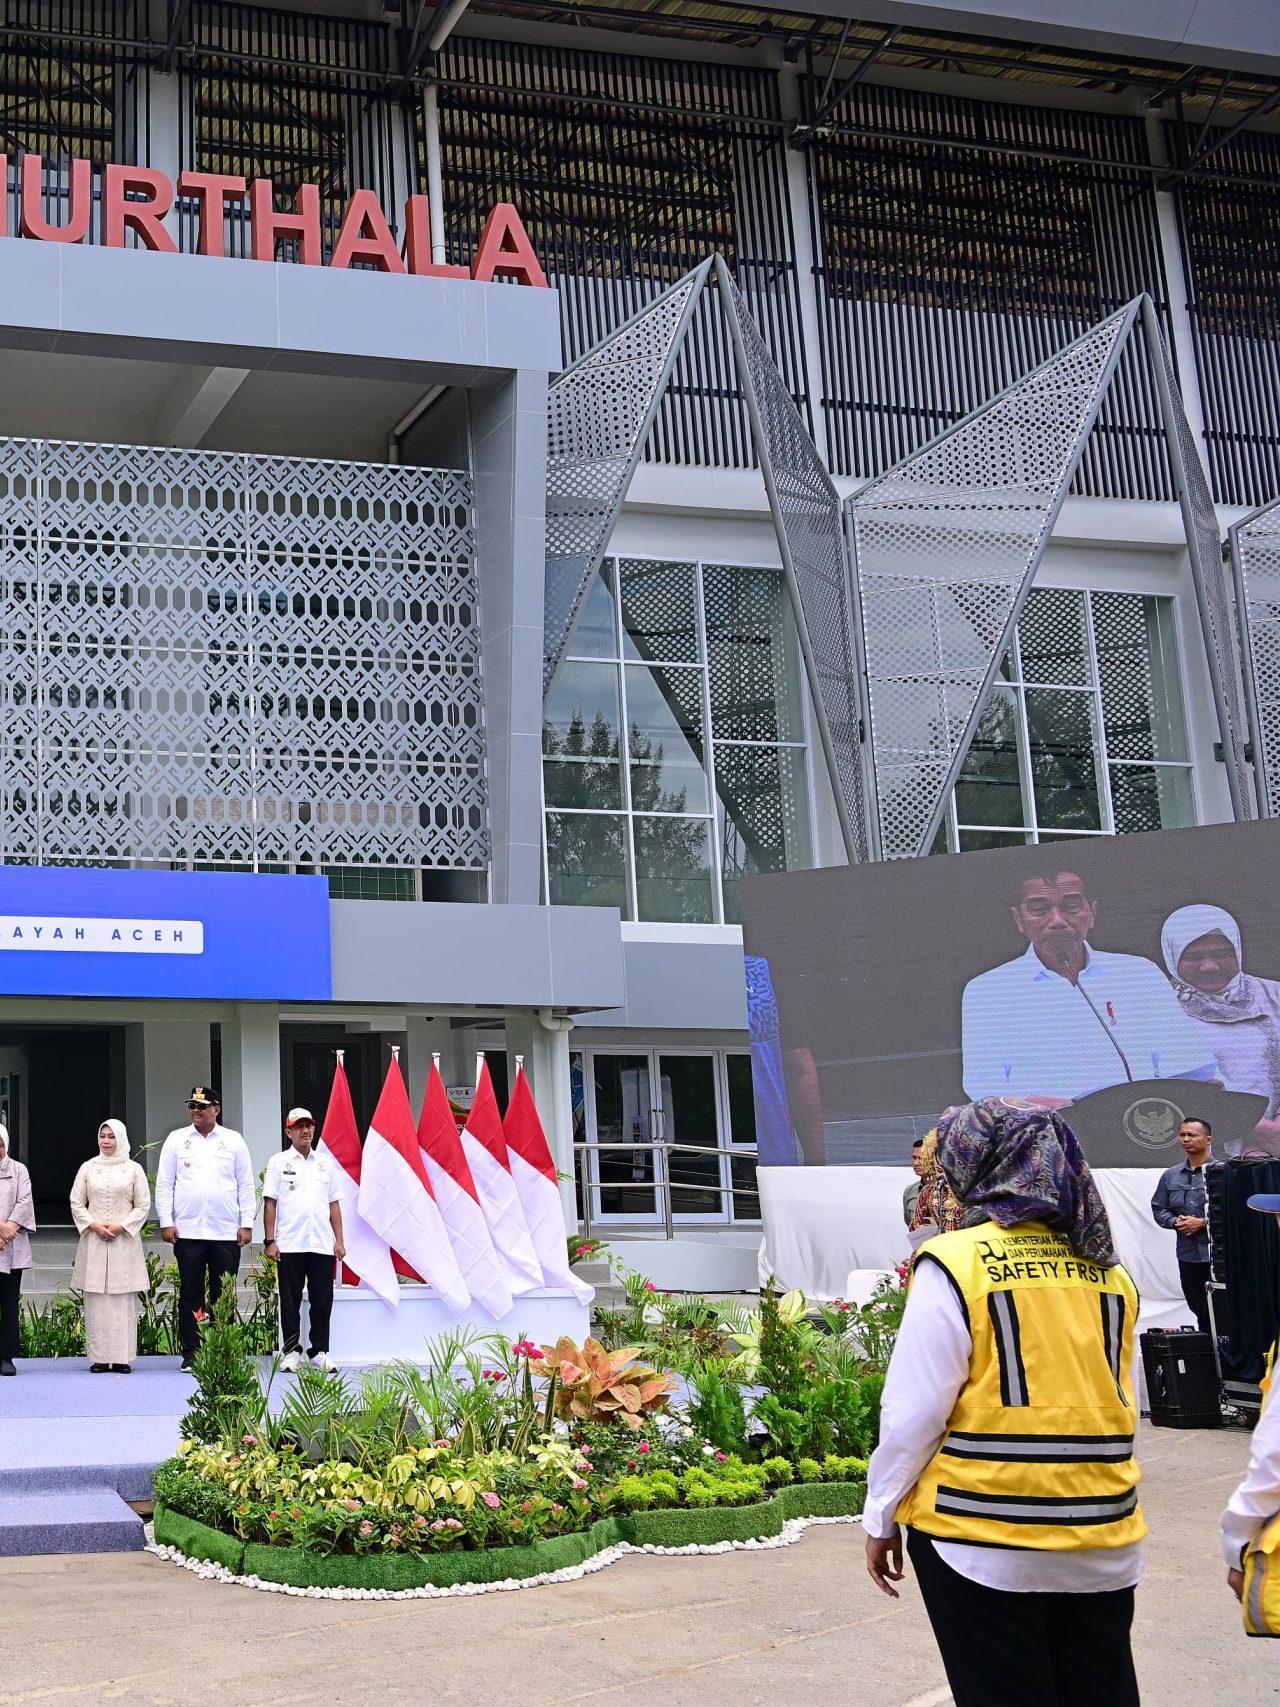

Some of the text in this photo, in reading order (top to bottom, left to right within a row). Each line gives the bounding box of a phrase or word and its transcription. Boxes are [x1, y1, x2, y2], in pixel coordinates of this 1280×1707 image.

[111, 928, 183, 942] ACEH
[1001, 1235, 1052, 1247] KEMENTERIAN
[1007, 1249, 1024, 1259] DAN
[1024, 1247, 1067, 1259] PERUMAHAN
[987, 1261, 1109, 1285] SAFETY FIRST
